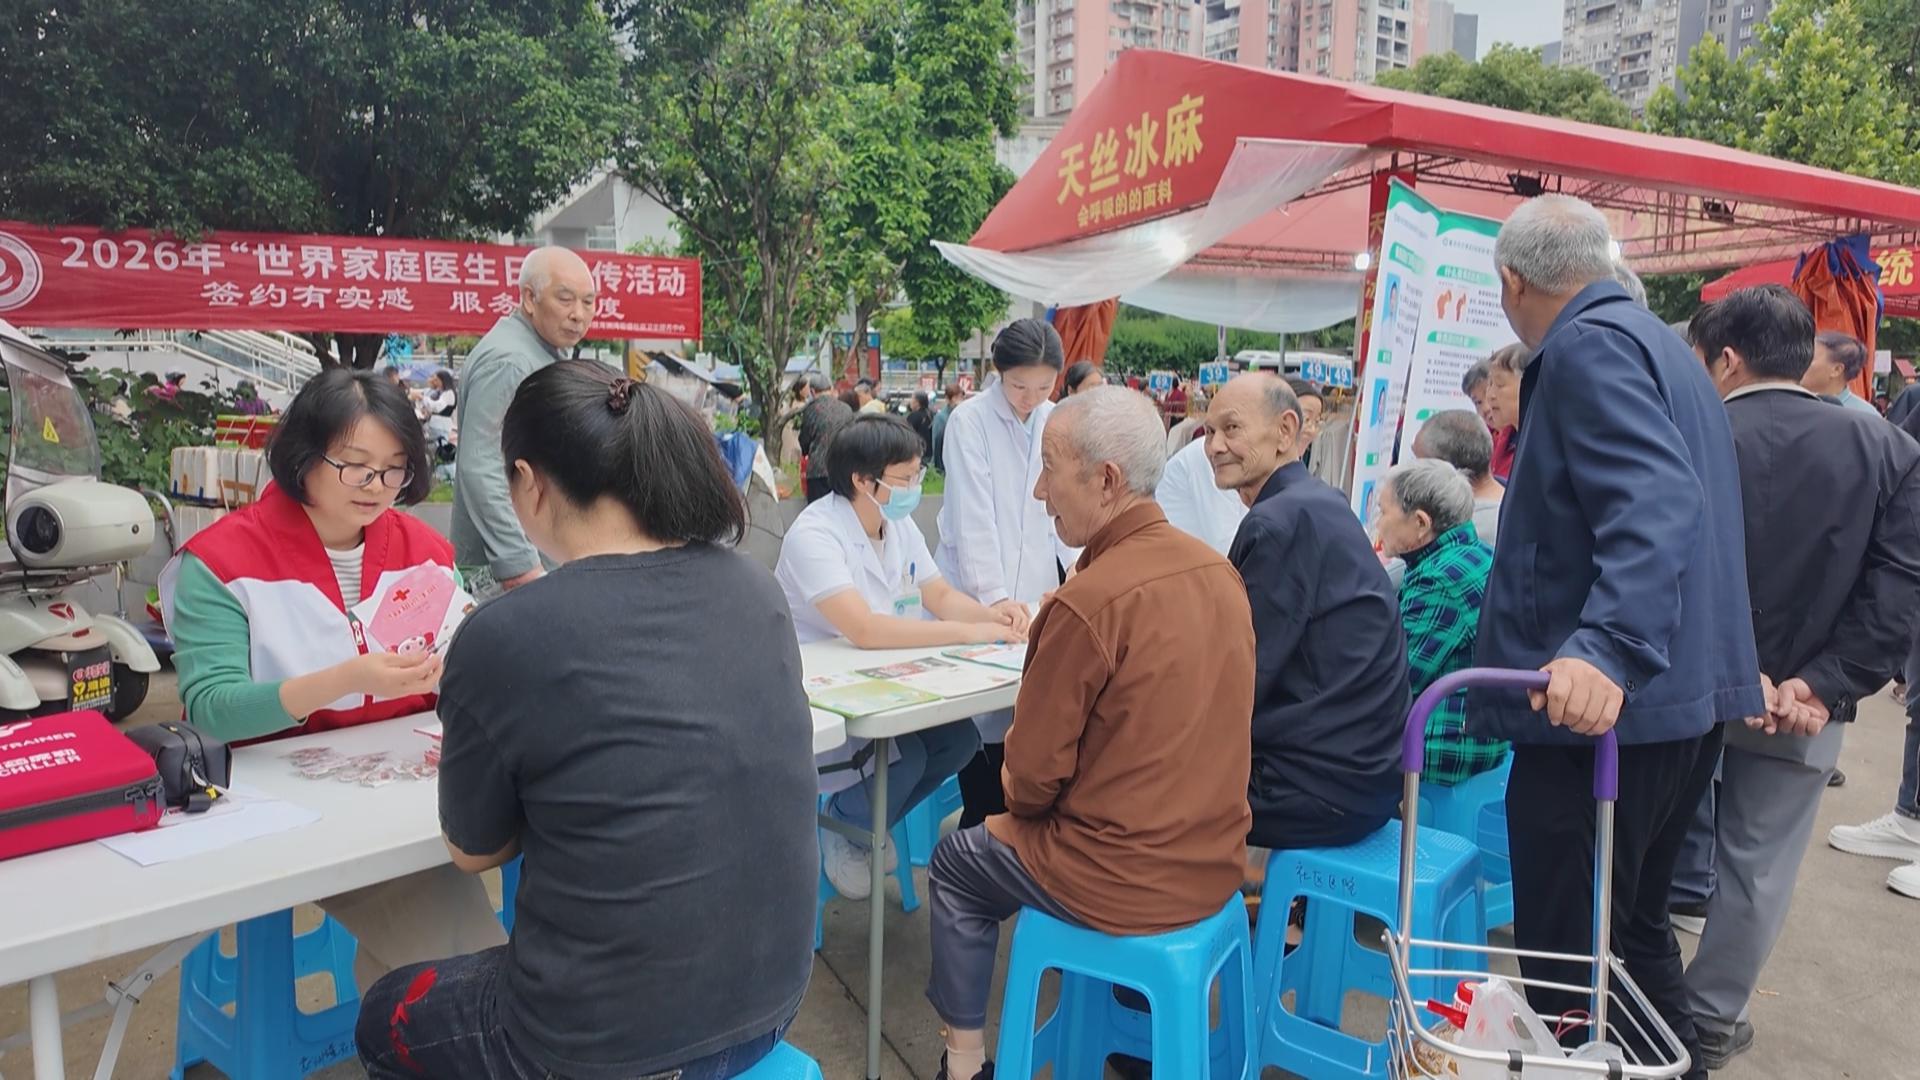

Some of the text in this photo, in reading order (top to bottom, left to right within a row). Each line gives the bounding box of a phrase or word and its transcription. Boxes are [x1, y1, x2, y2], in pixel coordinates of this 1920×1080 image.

[1057, 94, 1204, 205] 天丝冰麻
[1077, 177, 1173, 228] 会呼吸的的面料
[1875, 248, 1914, 287] 统
[200, 281, 625, 320] 签约有实感 服务度
